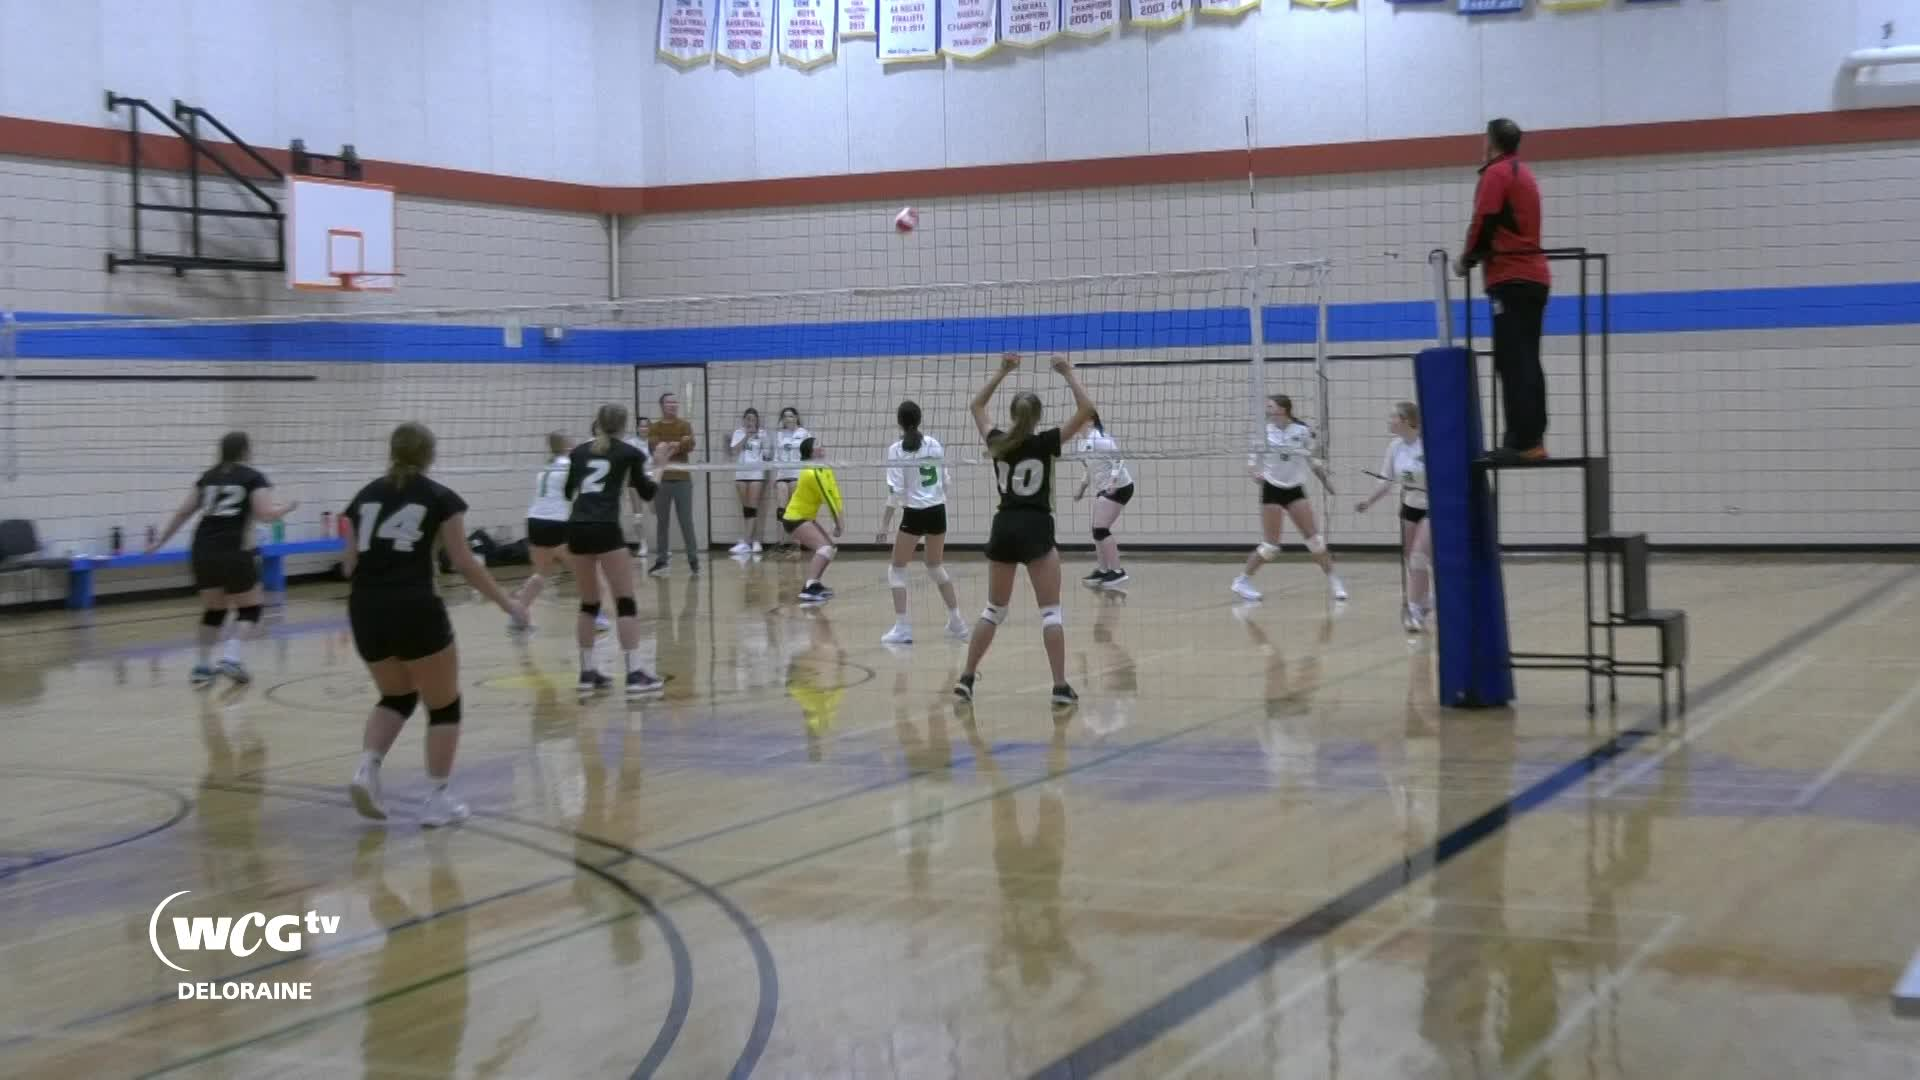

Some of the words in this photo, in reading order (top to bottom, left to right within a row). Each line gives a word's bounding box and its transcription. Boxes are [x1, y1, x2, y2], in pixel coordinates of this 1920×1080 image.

[580, 459, 611, 494] 2
[996, 459, 1044, 496] 10
[203, 485, 247, 517] 12
[358, 502, 428, 552] 14
